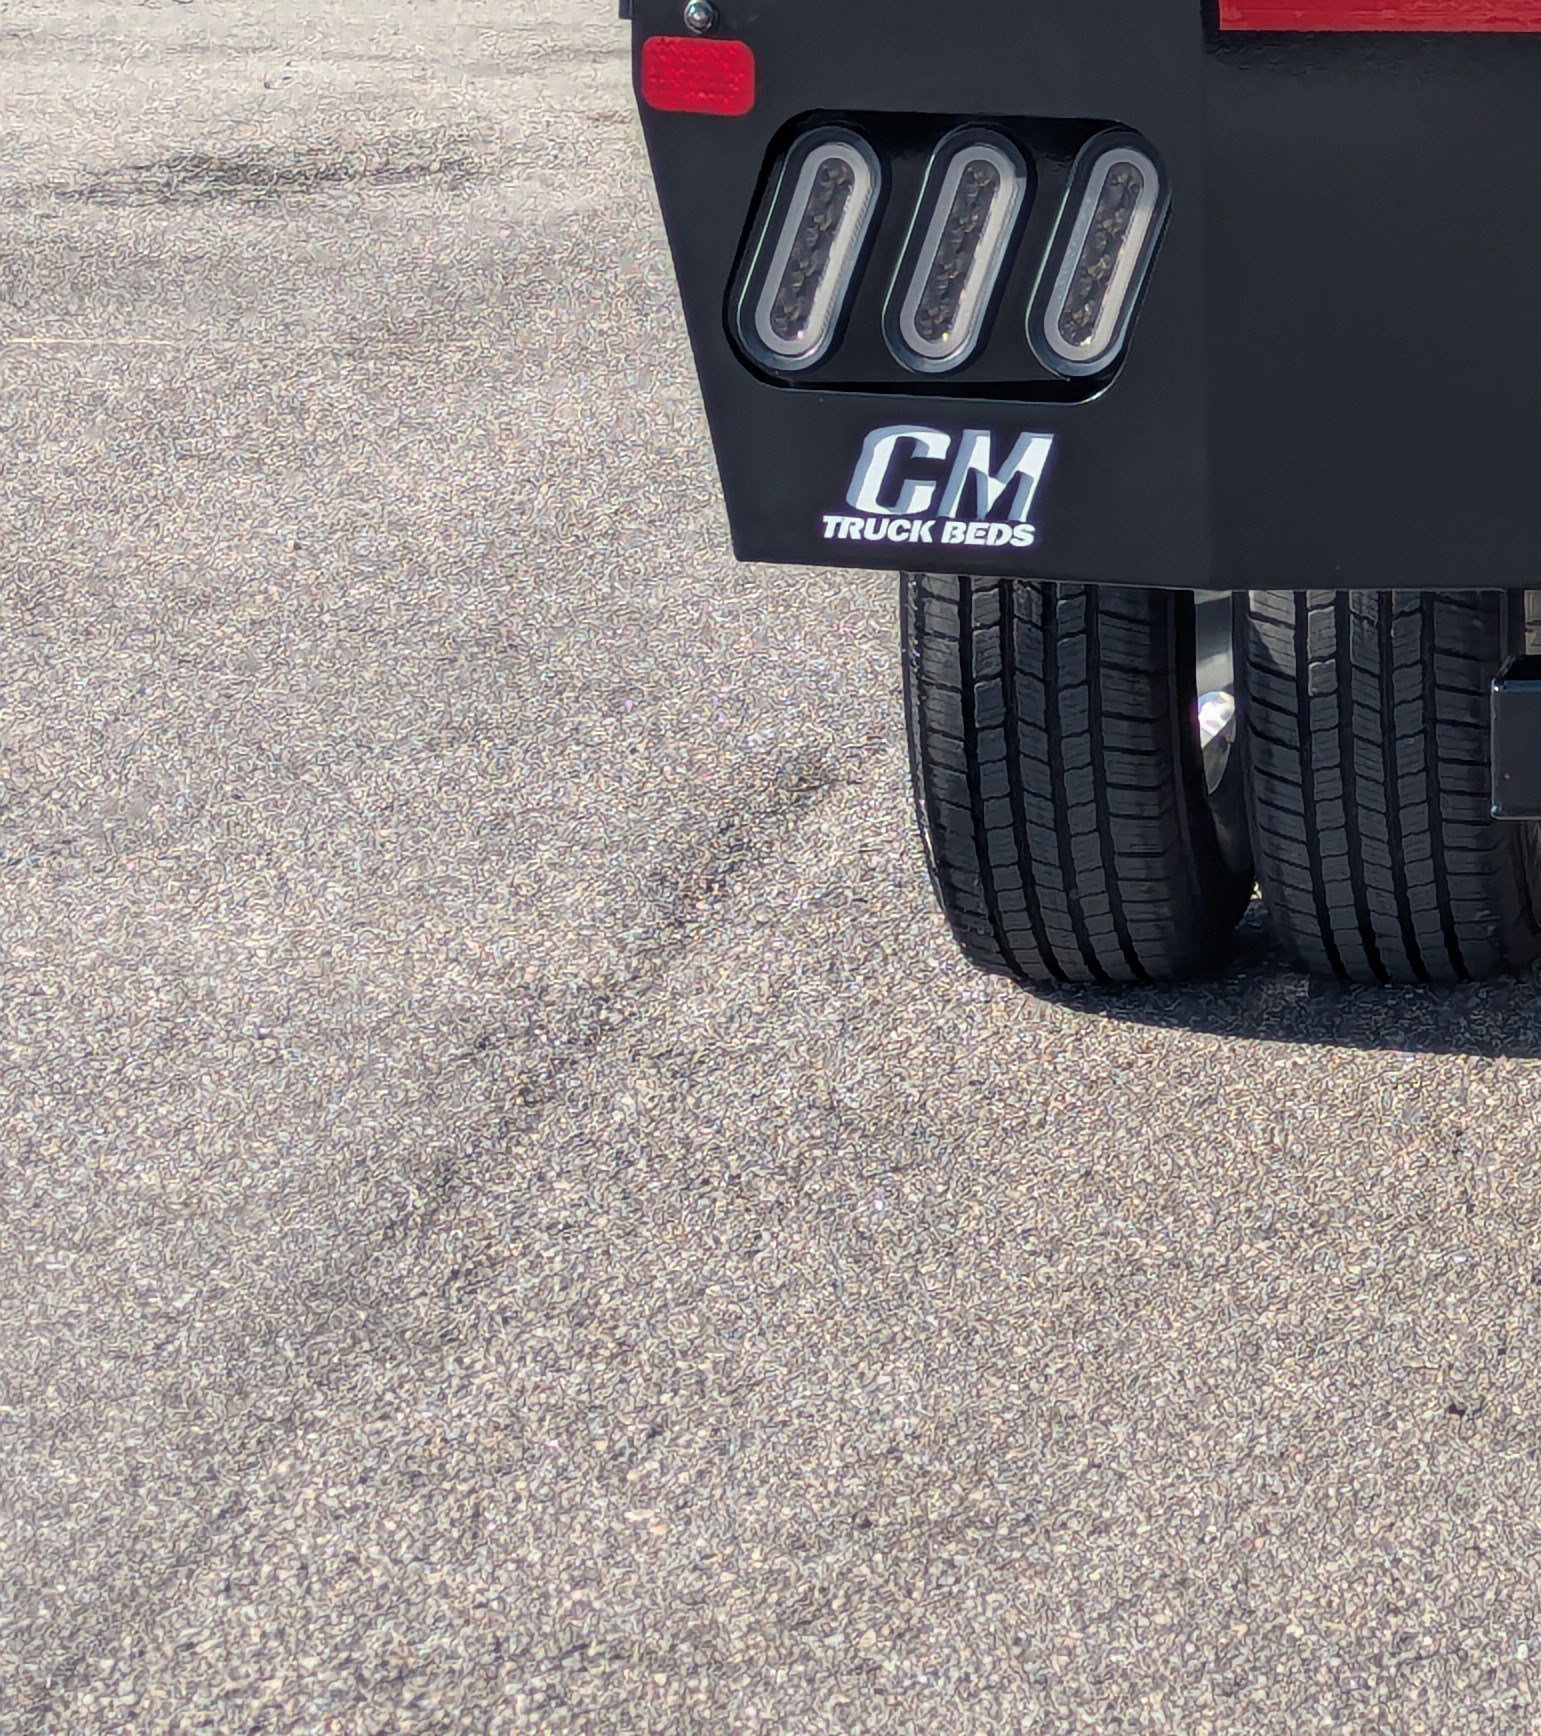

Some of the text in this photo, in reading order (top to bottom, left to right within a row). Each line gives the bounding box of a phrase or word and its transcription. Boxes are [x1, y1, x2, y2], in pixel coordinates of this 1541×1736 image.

[845, 424, 1054, 523] CM
[822, 515, 1036, 547] TRUCK BEDS
